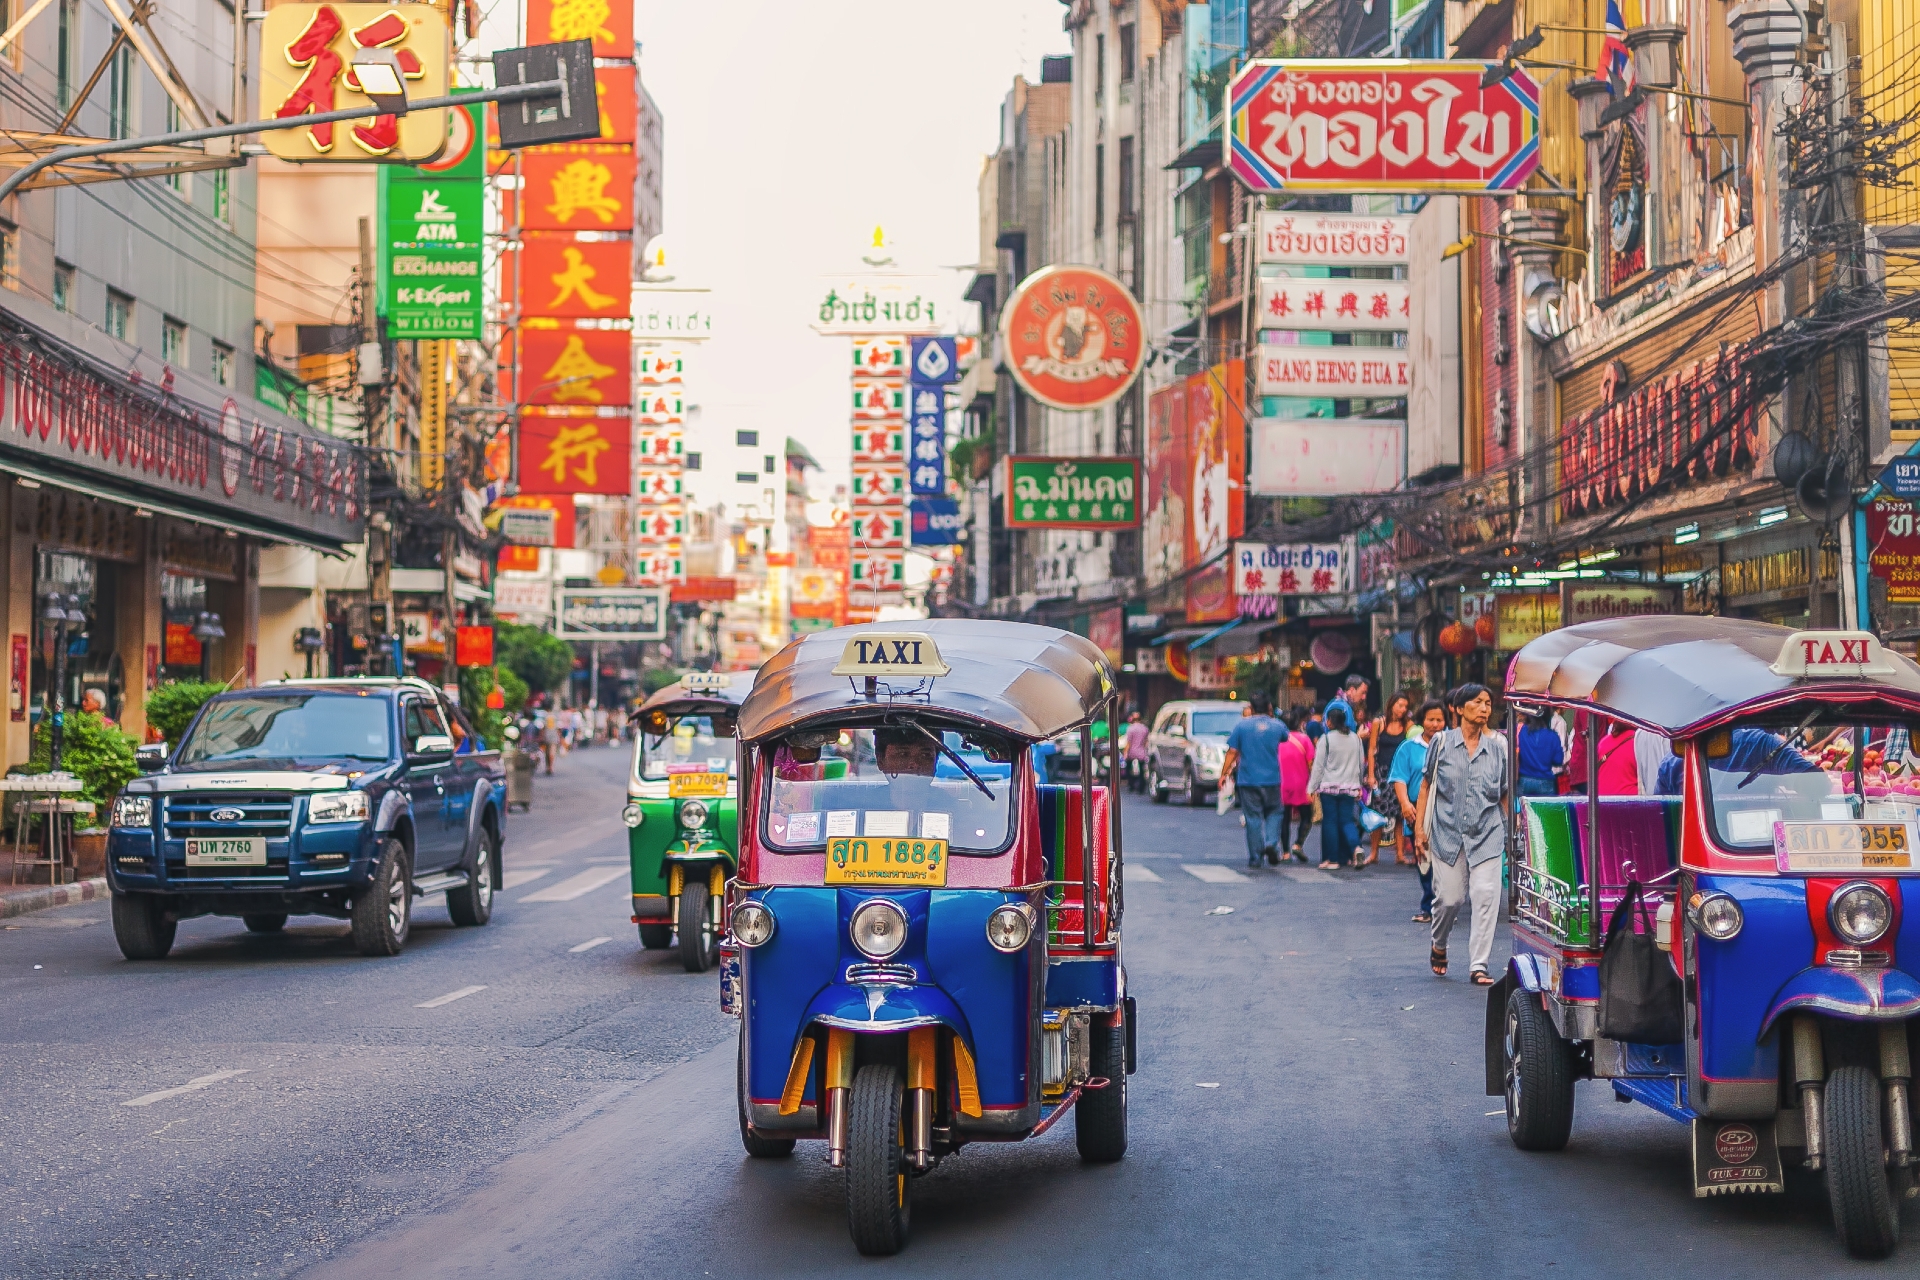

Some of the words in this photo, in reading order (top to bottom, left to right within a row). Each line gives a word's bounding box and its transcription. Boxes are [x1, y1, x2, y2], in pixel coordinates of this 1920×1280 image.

[273, 4, 426, 154] 行
[416, 223, 457, 240] ATM
[394, 261, 478, 275] EXCHANGE
[396, 317, 474, 329] WISDOM
[1267, 360, 1311, 382] SIANG
[1316, 361, 1357, 383] HENG
[1362, 361, 1392, 384] HUA
[854, 640, 922, 664] TAXI
[1801, 640, 1870, 664] TAXI
[222, 841, 252, 854] 2760
[1840, 825, 1905, 850] 2955
[883, 840, 942, 865] 1884
